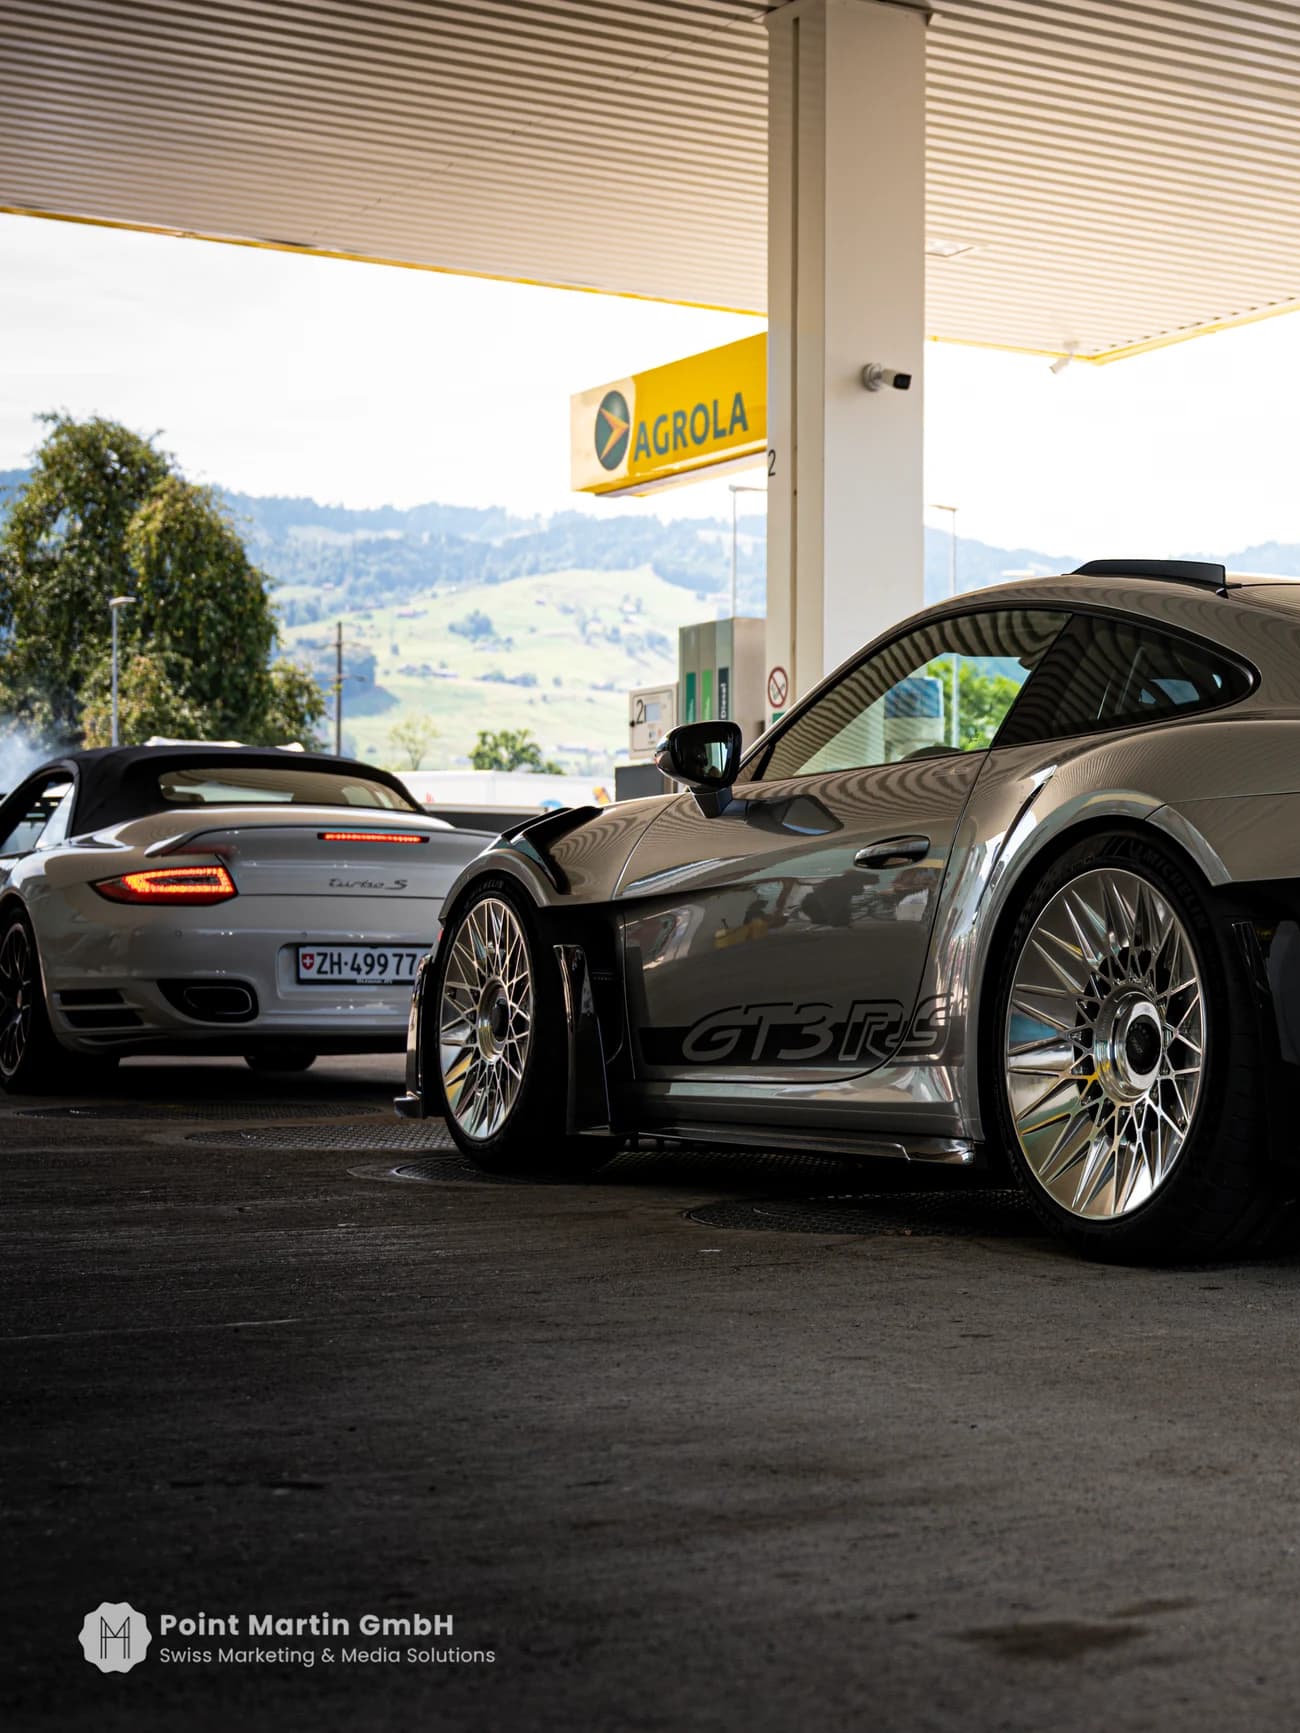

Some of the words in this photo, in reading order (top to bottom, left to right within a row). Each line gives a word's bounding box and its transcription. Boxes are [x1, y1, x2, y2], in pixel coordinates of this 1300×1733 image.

[633, 392, 749, 462] AGROLA
[768, 449, 776, 476] 2
[1143, 848, 1209, 928] MICHELIN
